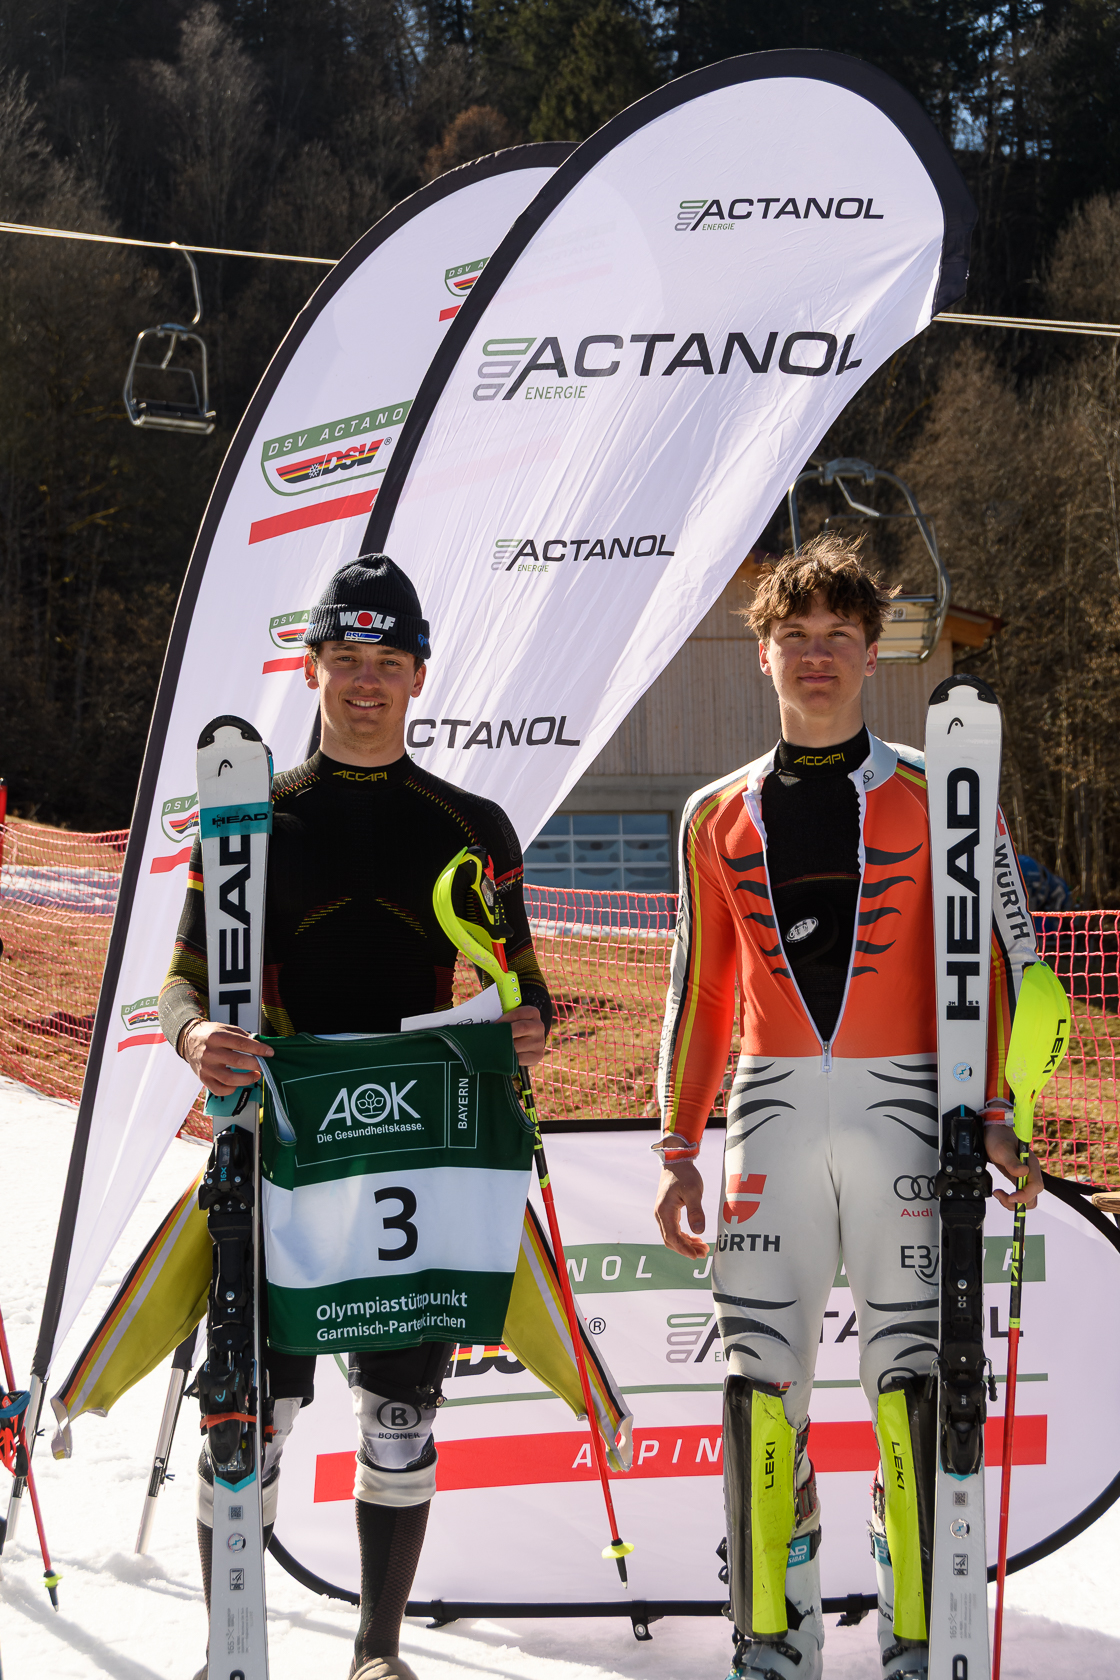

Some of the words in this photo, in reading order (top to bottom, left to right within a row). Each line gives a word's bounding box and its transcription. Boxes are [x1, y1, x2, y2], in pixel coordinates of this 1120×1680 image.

[690, 198, 885, 231] ACTANOL
[702, 223, 736, 231] ENERGIE
[449, 265, 471, 277] DSV
[502, 331, 862, 400] ACTANOL
[525, 385, 588, 400] ENERGIE
[268, 434, 308, 456] DSV
[505, 534, 675, 571] ACTANOL
[517, 564, 549, 573] ENERGIE
[272, 614, 295, 626] DSV
[406, 715, 581, 749] CTANOL
[793, 752, 846, 766] ACCAPI
[332, 770, 388, 781] ACCAPI
[164, 799, 192, 812] DSV
[946, 766, 981, 1020] HEAD
[1043, 1018, 1067, 1075] LEKI
[318, 1079, 421, 1131] AOK
[457, 1078, 469, 1129] BAYERN
[316, 1134, 333, 1144] Die
[335, 1122, 425, 1140] Gesundheitskasse.
[372, 1186, 419, 1261] 3
[900, 1208, 933, 1217] Audi
[378, 1432, 421, 1440] BOGNER
[571, 1437, 723, 1469] APIN
[765, 1441, 776, 1490] LEKI
[891, 1441, 905, 1491] LEKI
